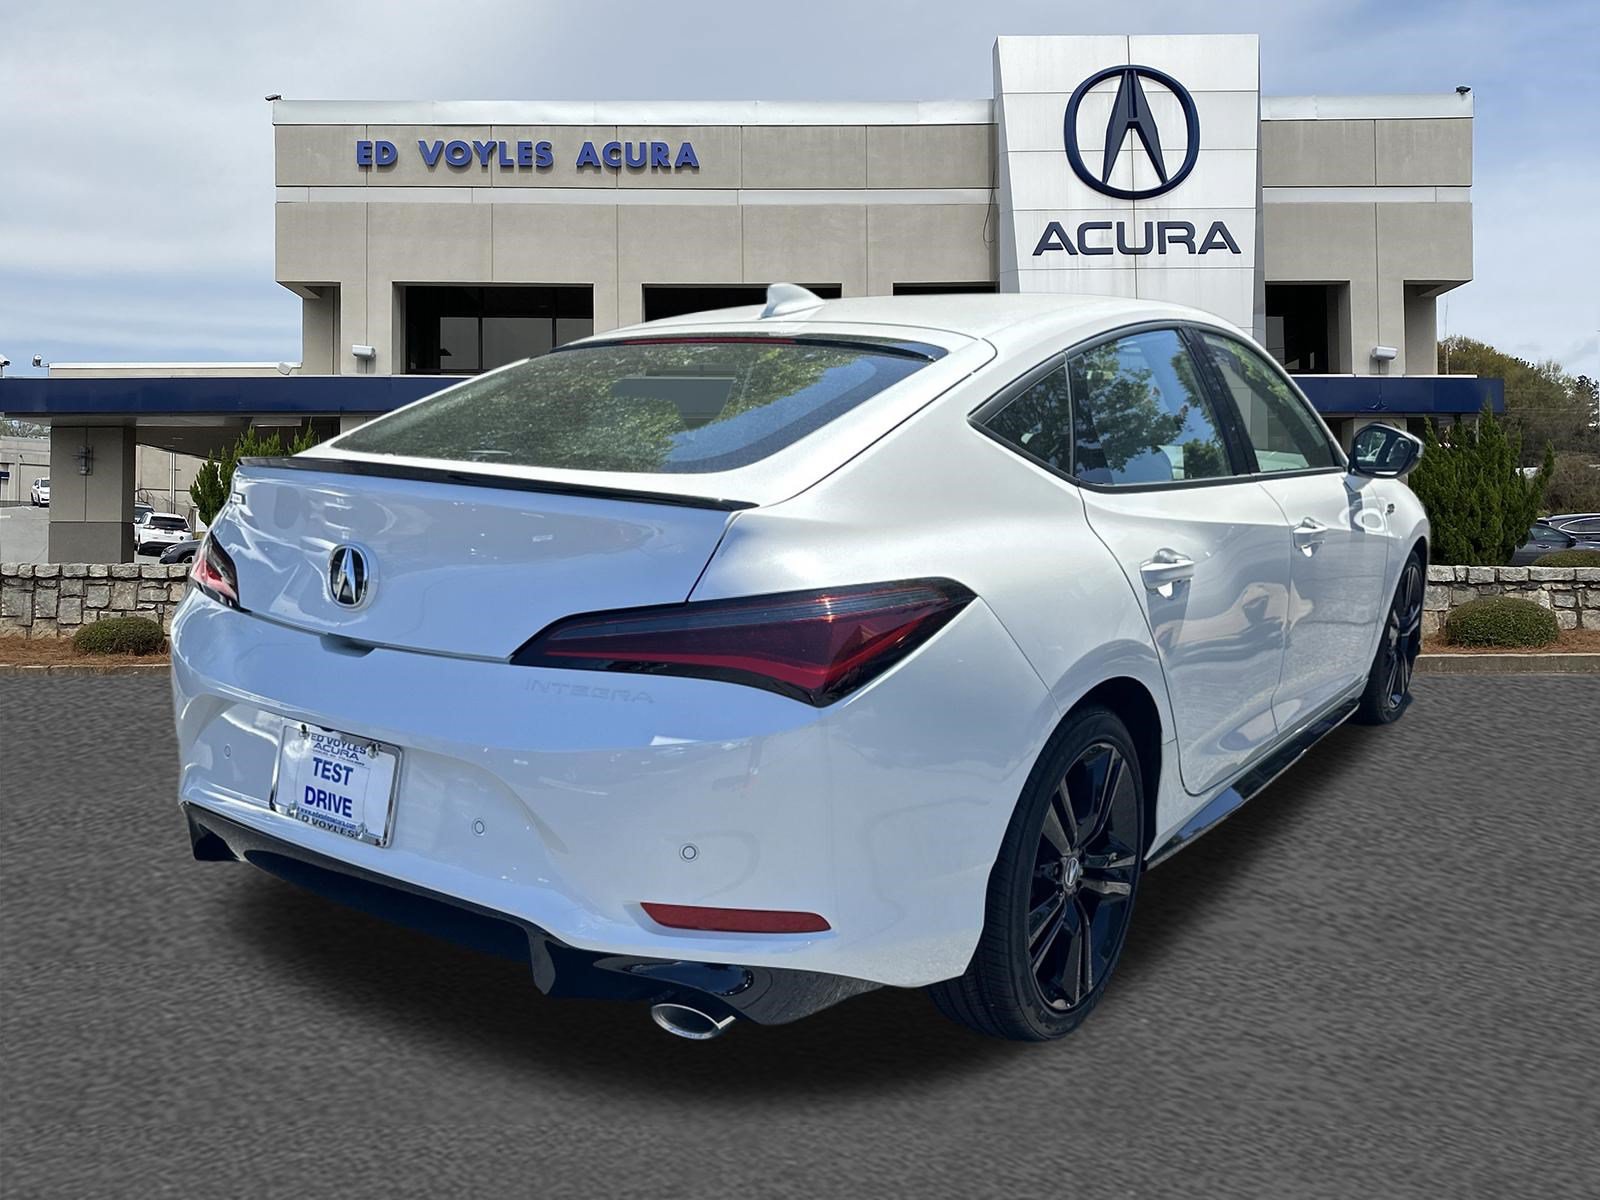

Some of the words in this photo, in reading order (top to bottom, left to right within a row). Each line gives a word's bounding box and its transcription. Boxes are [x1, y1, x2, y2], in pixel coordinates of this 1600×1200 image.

[356, 140, 398, 168] ED
[417, 140, 554, 168] VOYLES
[576, 141, 700, 169] ACURA
[1032, 221, 1242, 256] ACURA
[525, 678, 655, 703] INTEGRA
[311, 733, 324, 742] ED
[326, 737, 366, 755] VOYLES
[313, 742, 359, 760] ACURA
[312, 757, 354, 786] TEST
[304, 785, 353, 818] DRIVE
[312, 819, 354, 838] VOYLES
